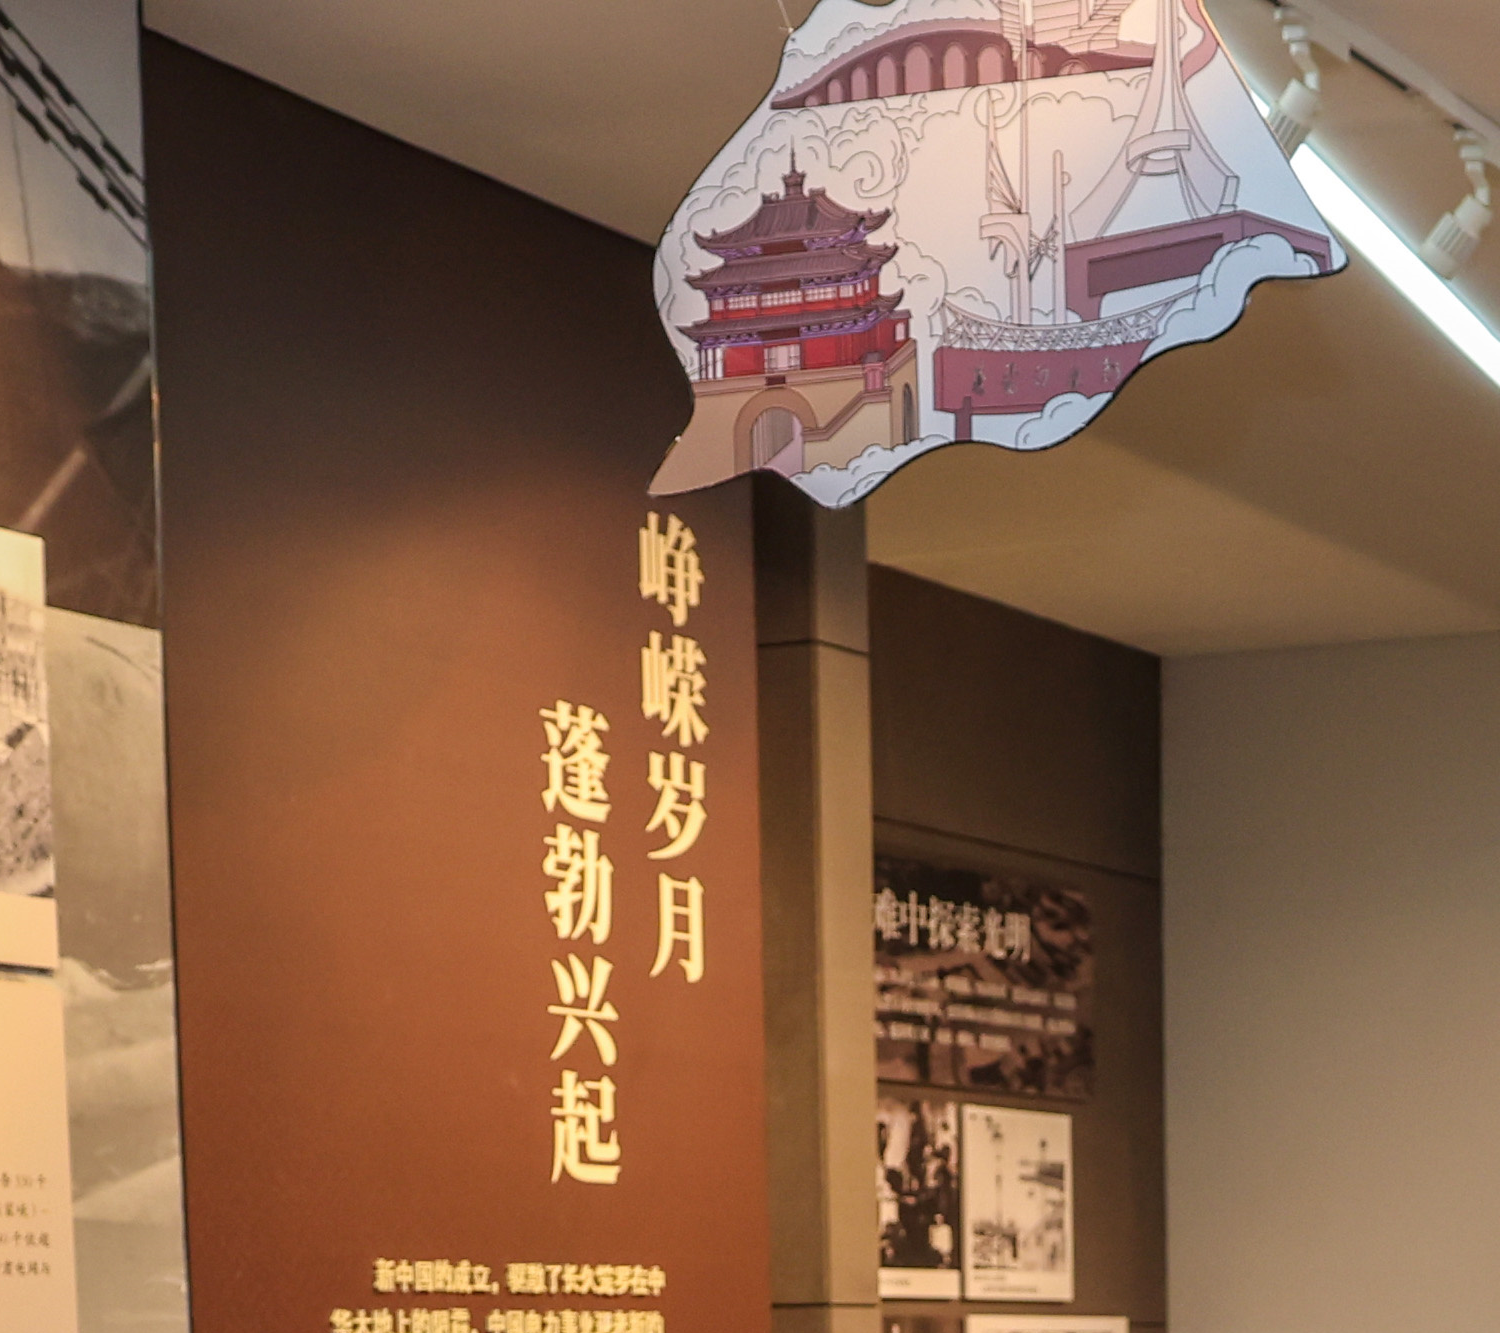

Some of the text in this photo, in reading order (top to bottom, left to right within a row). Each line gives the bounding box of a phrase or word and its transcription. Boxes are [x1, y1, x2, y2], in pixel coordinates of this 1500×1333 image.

[538, 698, 622, 1186] 蓬勃兴起
[638, 510, 710, 986] 峥嵘岁月
